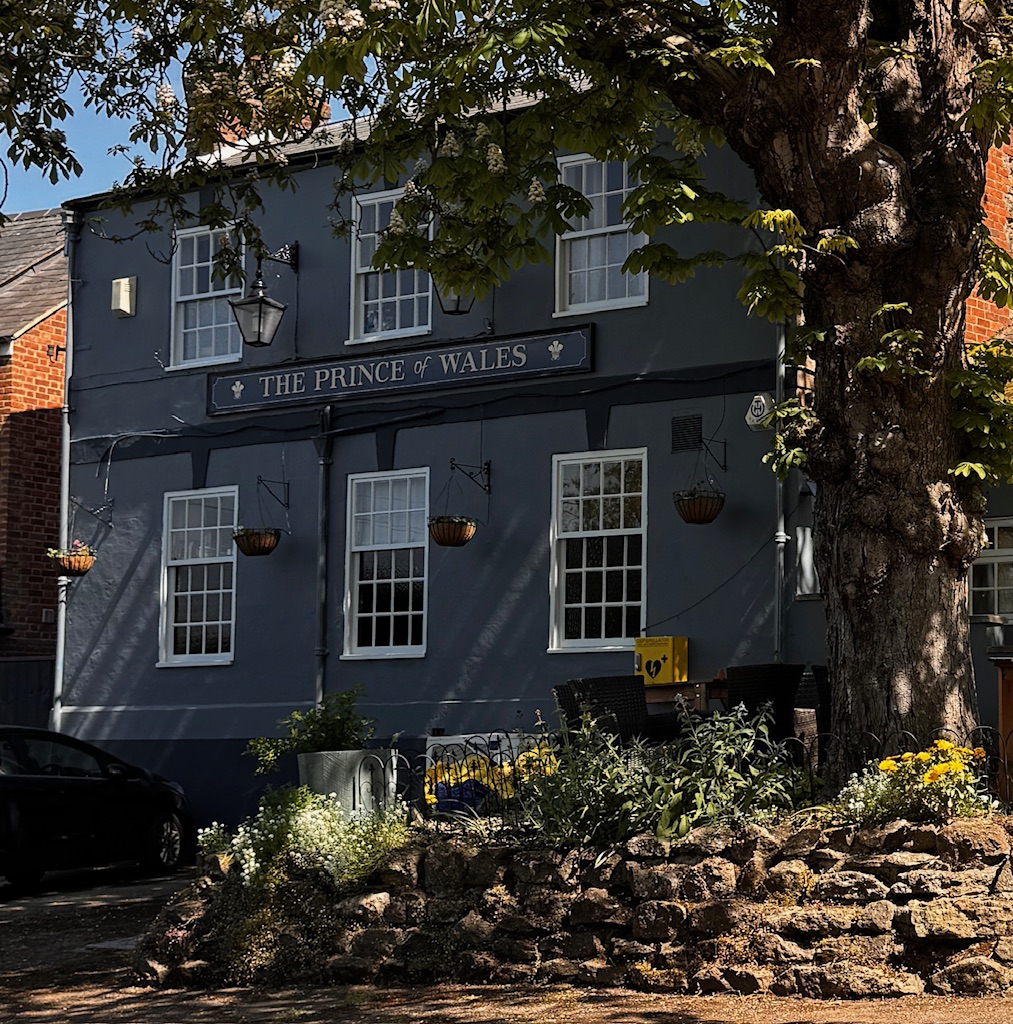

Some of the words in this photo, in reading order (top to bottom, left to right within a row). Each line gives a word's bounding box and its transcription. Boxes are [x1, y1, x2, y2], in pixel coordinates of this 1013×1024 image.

[259, 372, 306, 398] THE
[313, 360, 405, 391] PRINCE
[413, 355, 433, 379] of
[438, 344, 527, 374] WALES
